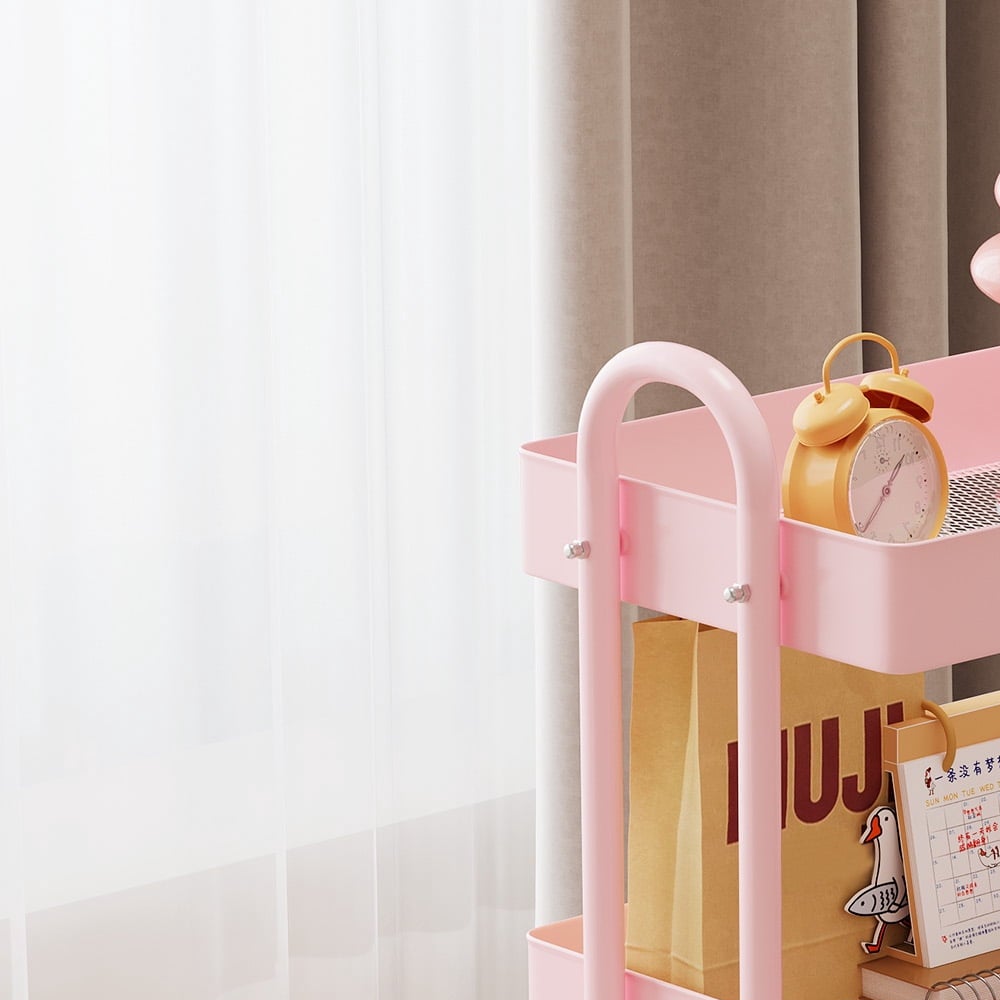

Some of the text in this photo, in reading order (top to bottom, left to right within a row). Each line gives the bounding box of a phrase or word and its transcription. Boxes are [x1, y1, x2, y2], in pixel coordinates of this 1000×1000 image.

[727, 701, 904, 845] UJ
[925, 797, 940, 807] SUN
[943, 792, 959, 801] MON
[961, 788, 976, 797] TUE
[980, 783, 994, 792] WED
